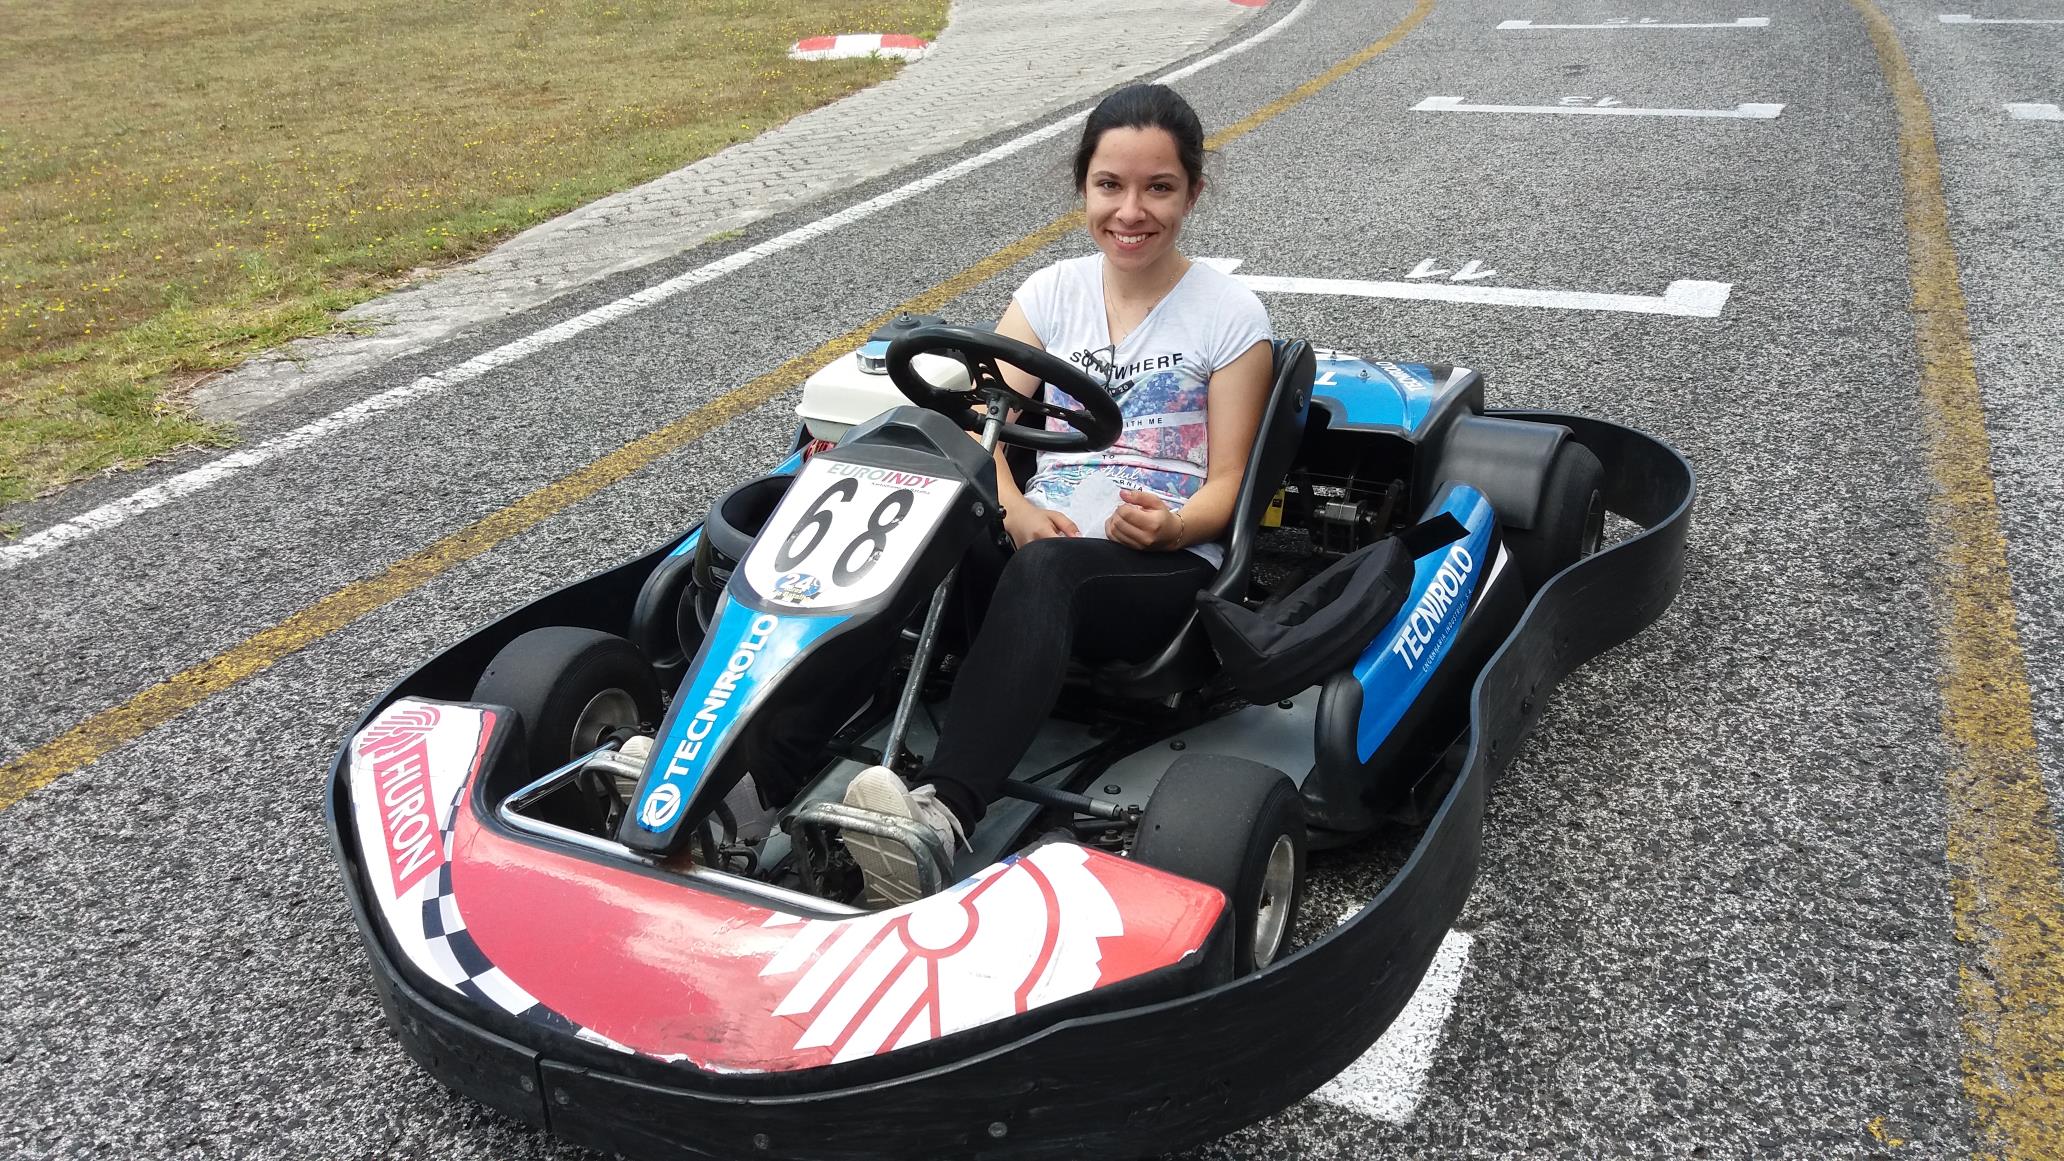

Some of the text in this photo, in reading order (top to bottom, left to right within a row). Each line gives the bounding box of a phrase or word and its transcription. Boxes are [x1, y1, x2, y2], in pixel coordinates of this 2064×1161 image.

[827, 463, 937, 488] EUROINDY
[1126, 417, 1163, 428] ITH ME
[774, 477, 915, 588] 68
[1393, 545, 1473, 670] TECNIROLO
[664, 614, 779, 781] TECNIROLO
[381, 753, 436, 882] HURON
